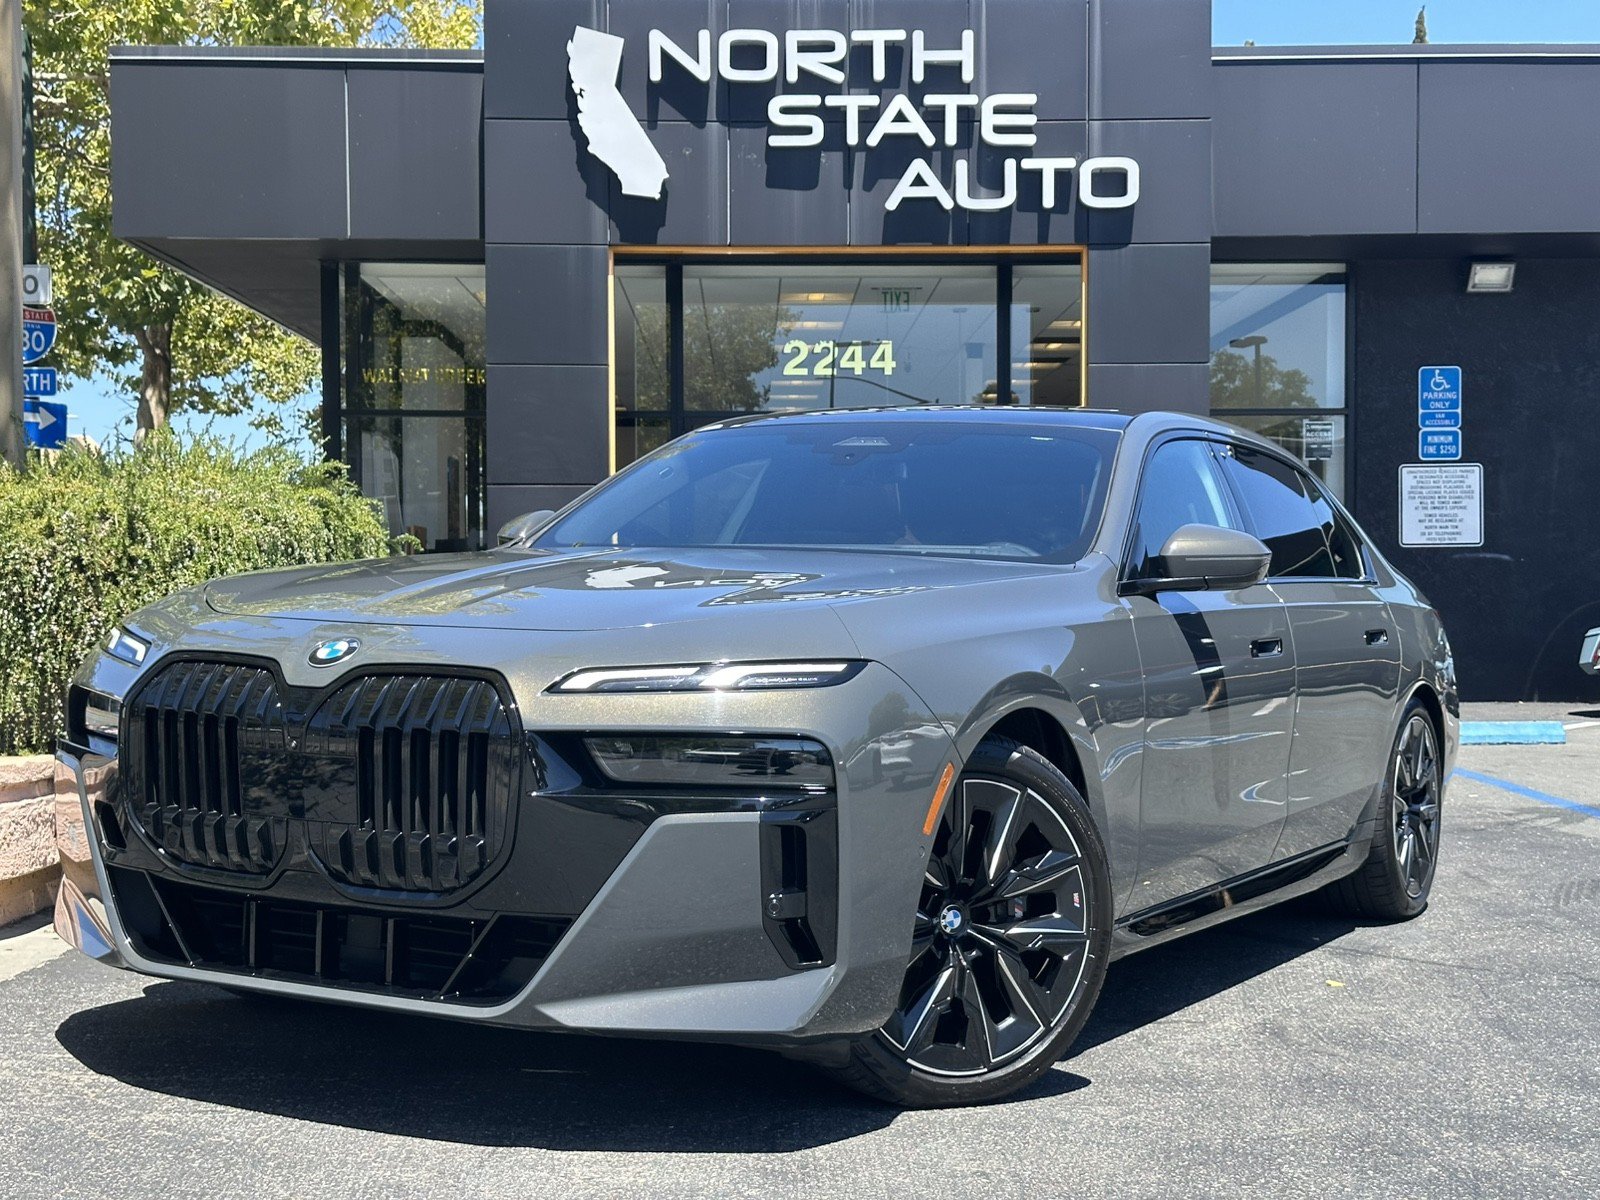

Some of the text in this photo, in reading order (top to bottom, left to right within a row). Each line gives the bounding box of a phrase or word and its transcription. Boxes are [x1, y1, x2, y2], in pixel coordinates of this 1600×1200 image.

[648, 28, 974, 84] NORTH
[767, 93, 1038, 148] STATE
[884, 156, 1140, 212] AUTO
[23, 274, 39, 295] O
[24, 310, 50, 321] STATE
[23, 330, 46, 352] 80
[782, 339, 896, 376] 2244
[23, 373, 51, 391] RTH
[362, 367, 486, 384] WALNUT CREEK
[1423, 391, 1457, 399] PARKING
[1429, 401, 1451, 409] ONLY
[1427, 435, 1453, 443] MINIMUM
[1423, 445, 1457, 454] FINE $250
